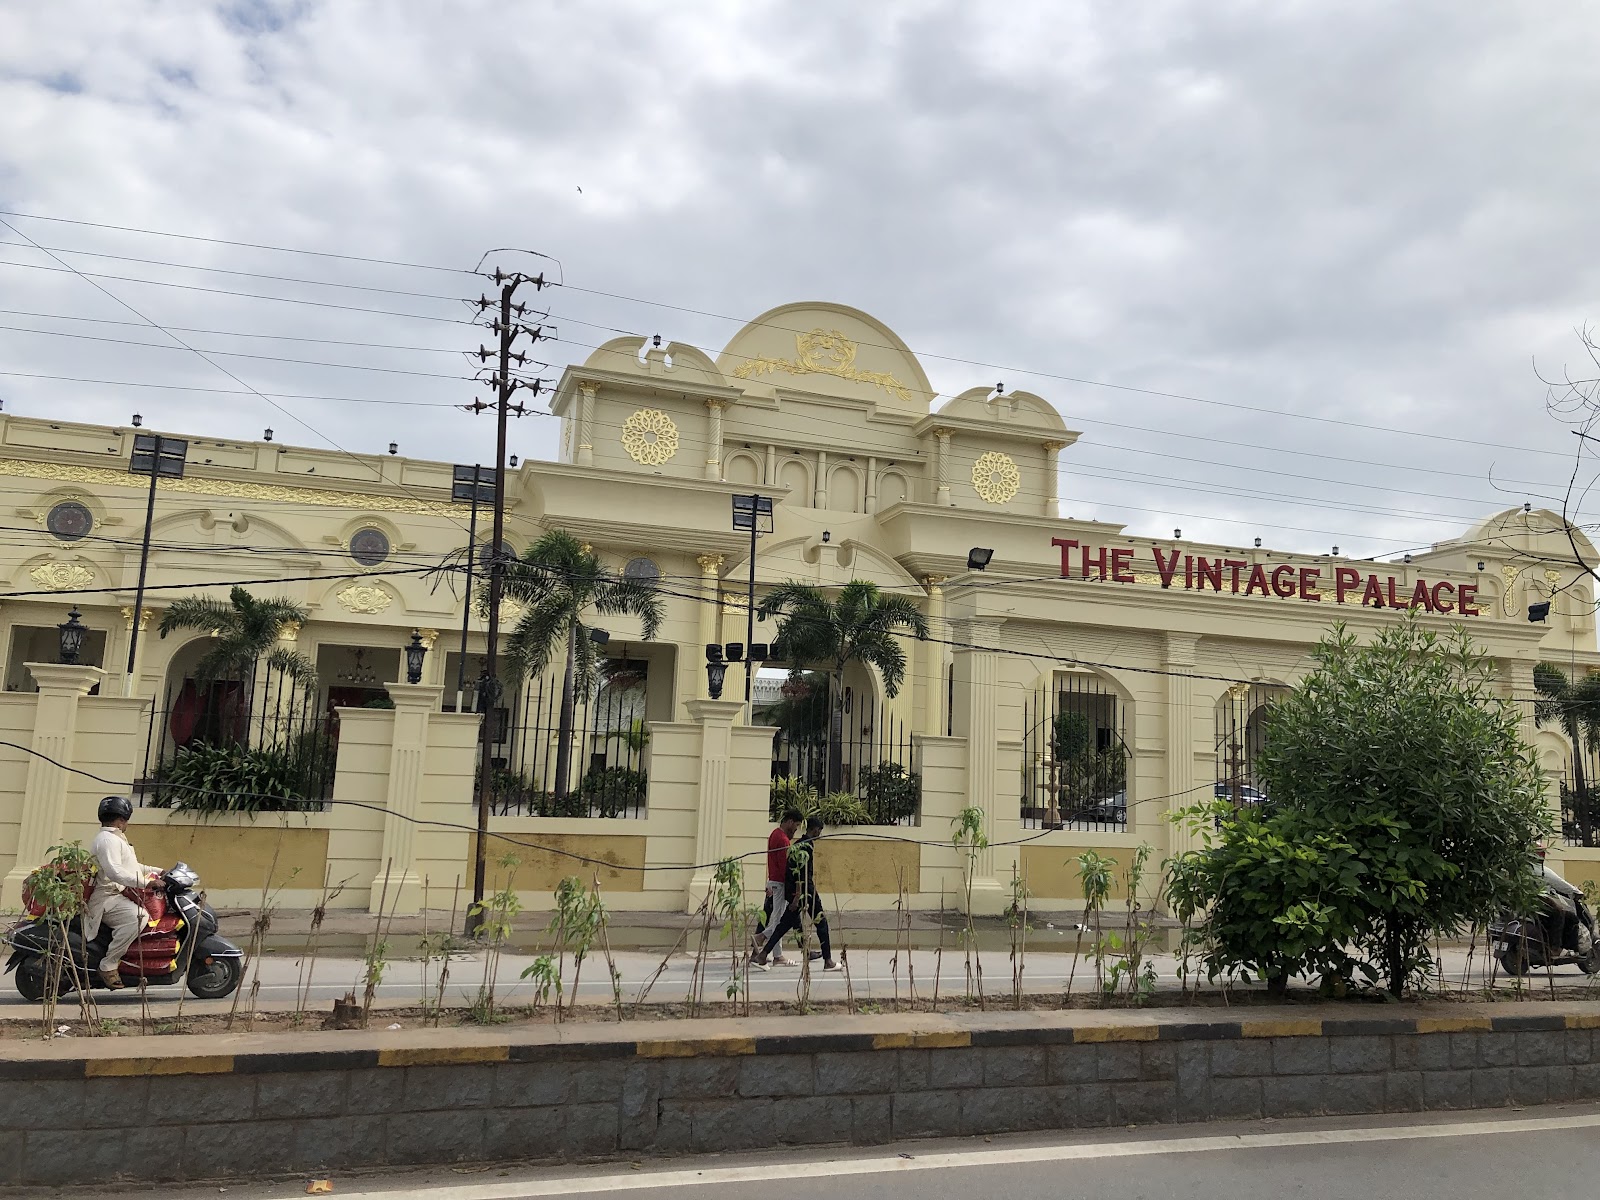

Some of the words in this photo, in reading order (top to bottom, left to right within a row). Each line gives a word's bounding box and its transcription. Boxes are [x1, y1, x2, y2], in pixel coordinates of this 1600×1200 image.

[1052, 537, 1135, 583] THE
[1152, 547, 1321, 601] VINTAGE
[1336, 567, 1480, 615] PALACE
